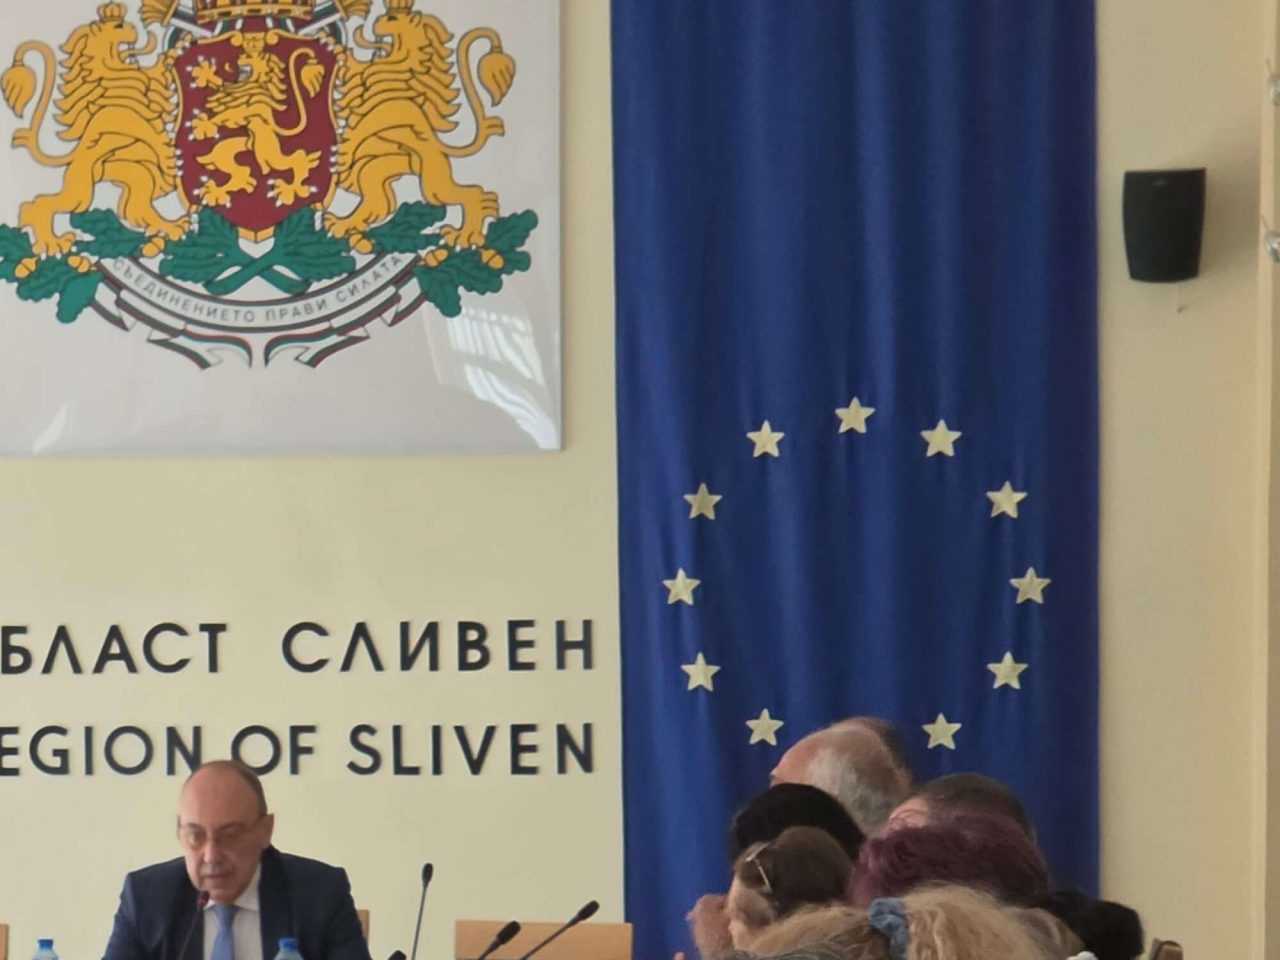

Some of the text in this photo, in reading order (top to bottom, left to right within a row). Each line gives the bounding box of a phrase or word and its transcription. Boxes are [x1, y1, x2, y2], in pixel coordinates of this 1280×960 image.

[113, 255, 403, 323] СЪЕДИНЕНИЕТО ПРАВИ СИЛАТА
[281, 619, 594, 674] СЛИВЕН
[230, 724, 318, 777] OF
[346, 722, 595, 777] SLIVEN
